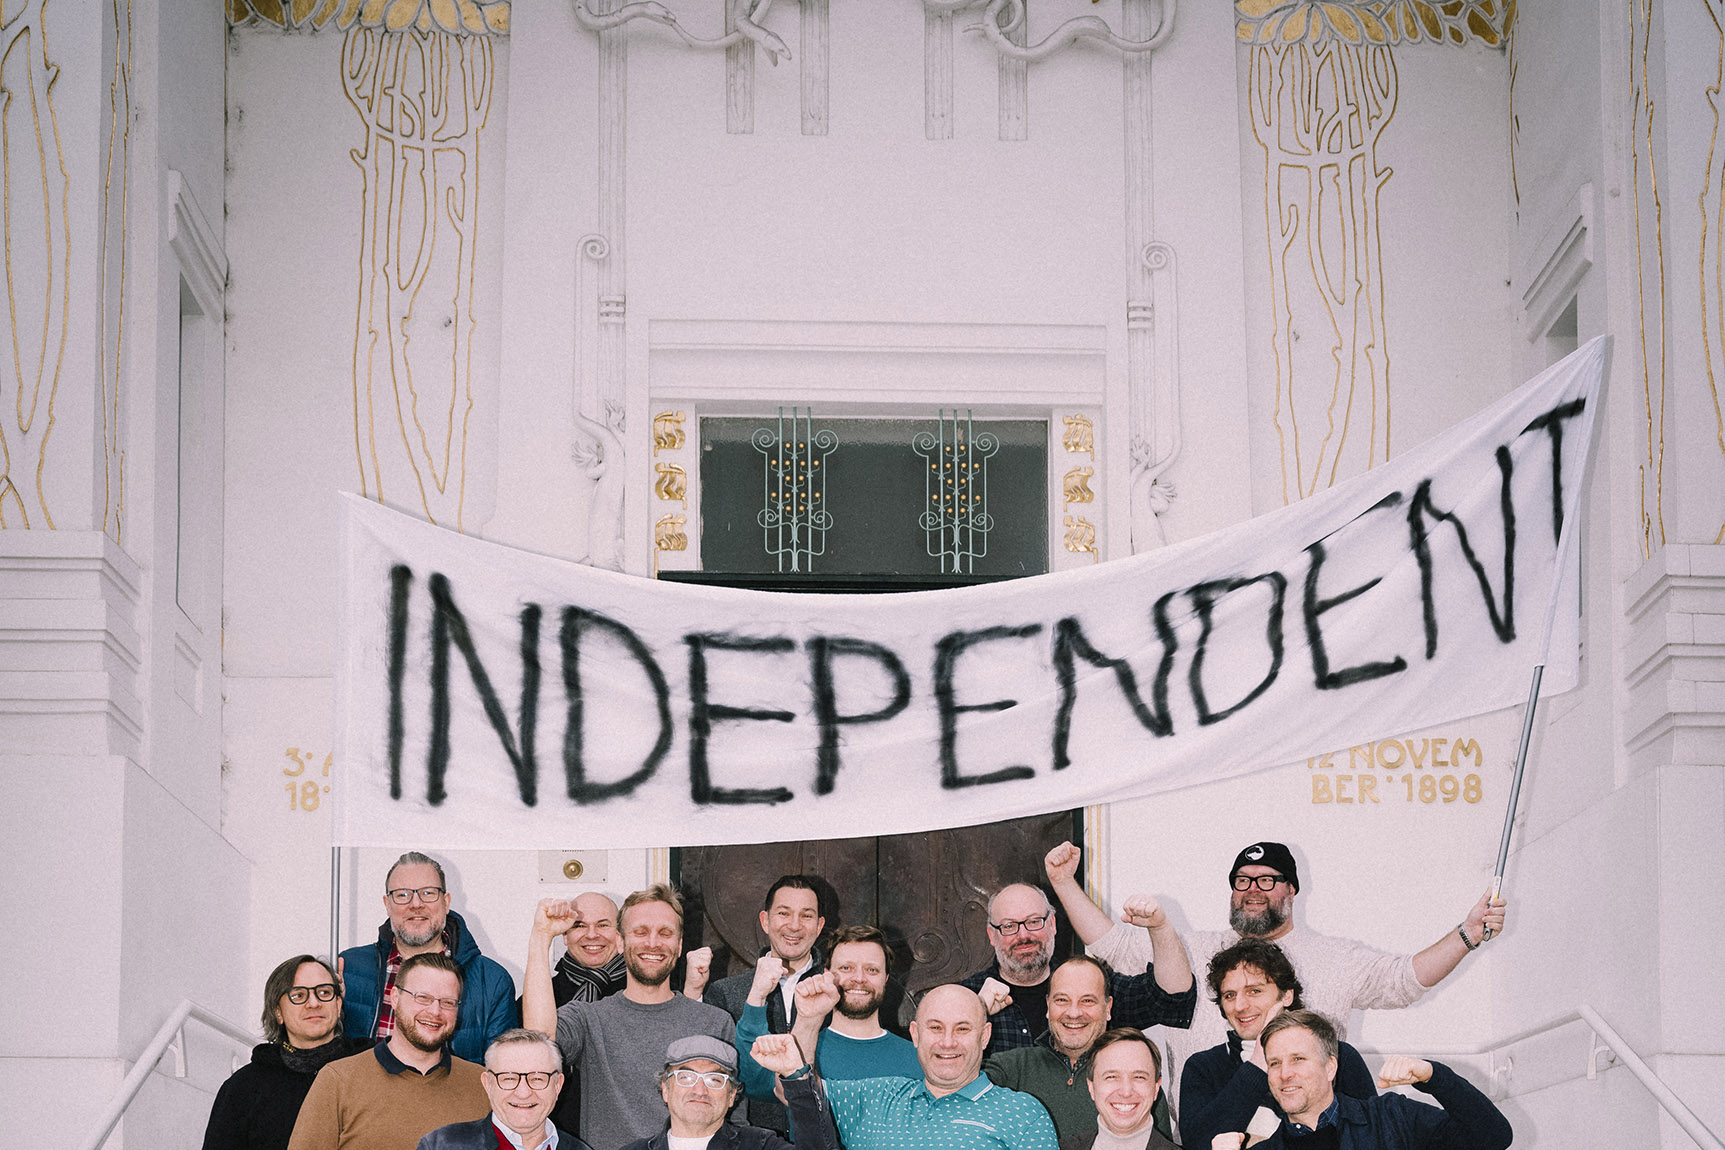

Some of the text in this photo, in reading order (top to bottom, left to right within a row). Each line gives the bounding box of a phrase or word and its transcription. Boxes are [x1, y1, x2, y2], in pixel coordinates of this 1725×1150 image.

[387, 396, 1588, 808] INDEPENDENT
[1348, 737, 1483, 770] NOVEM
[1401, 773, 1483, 805] 1898
